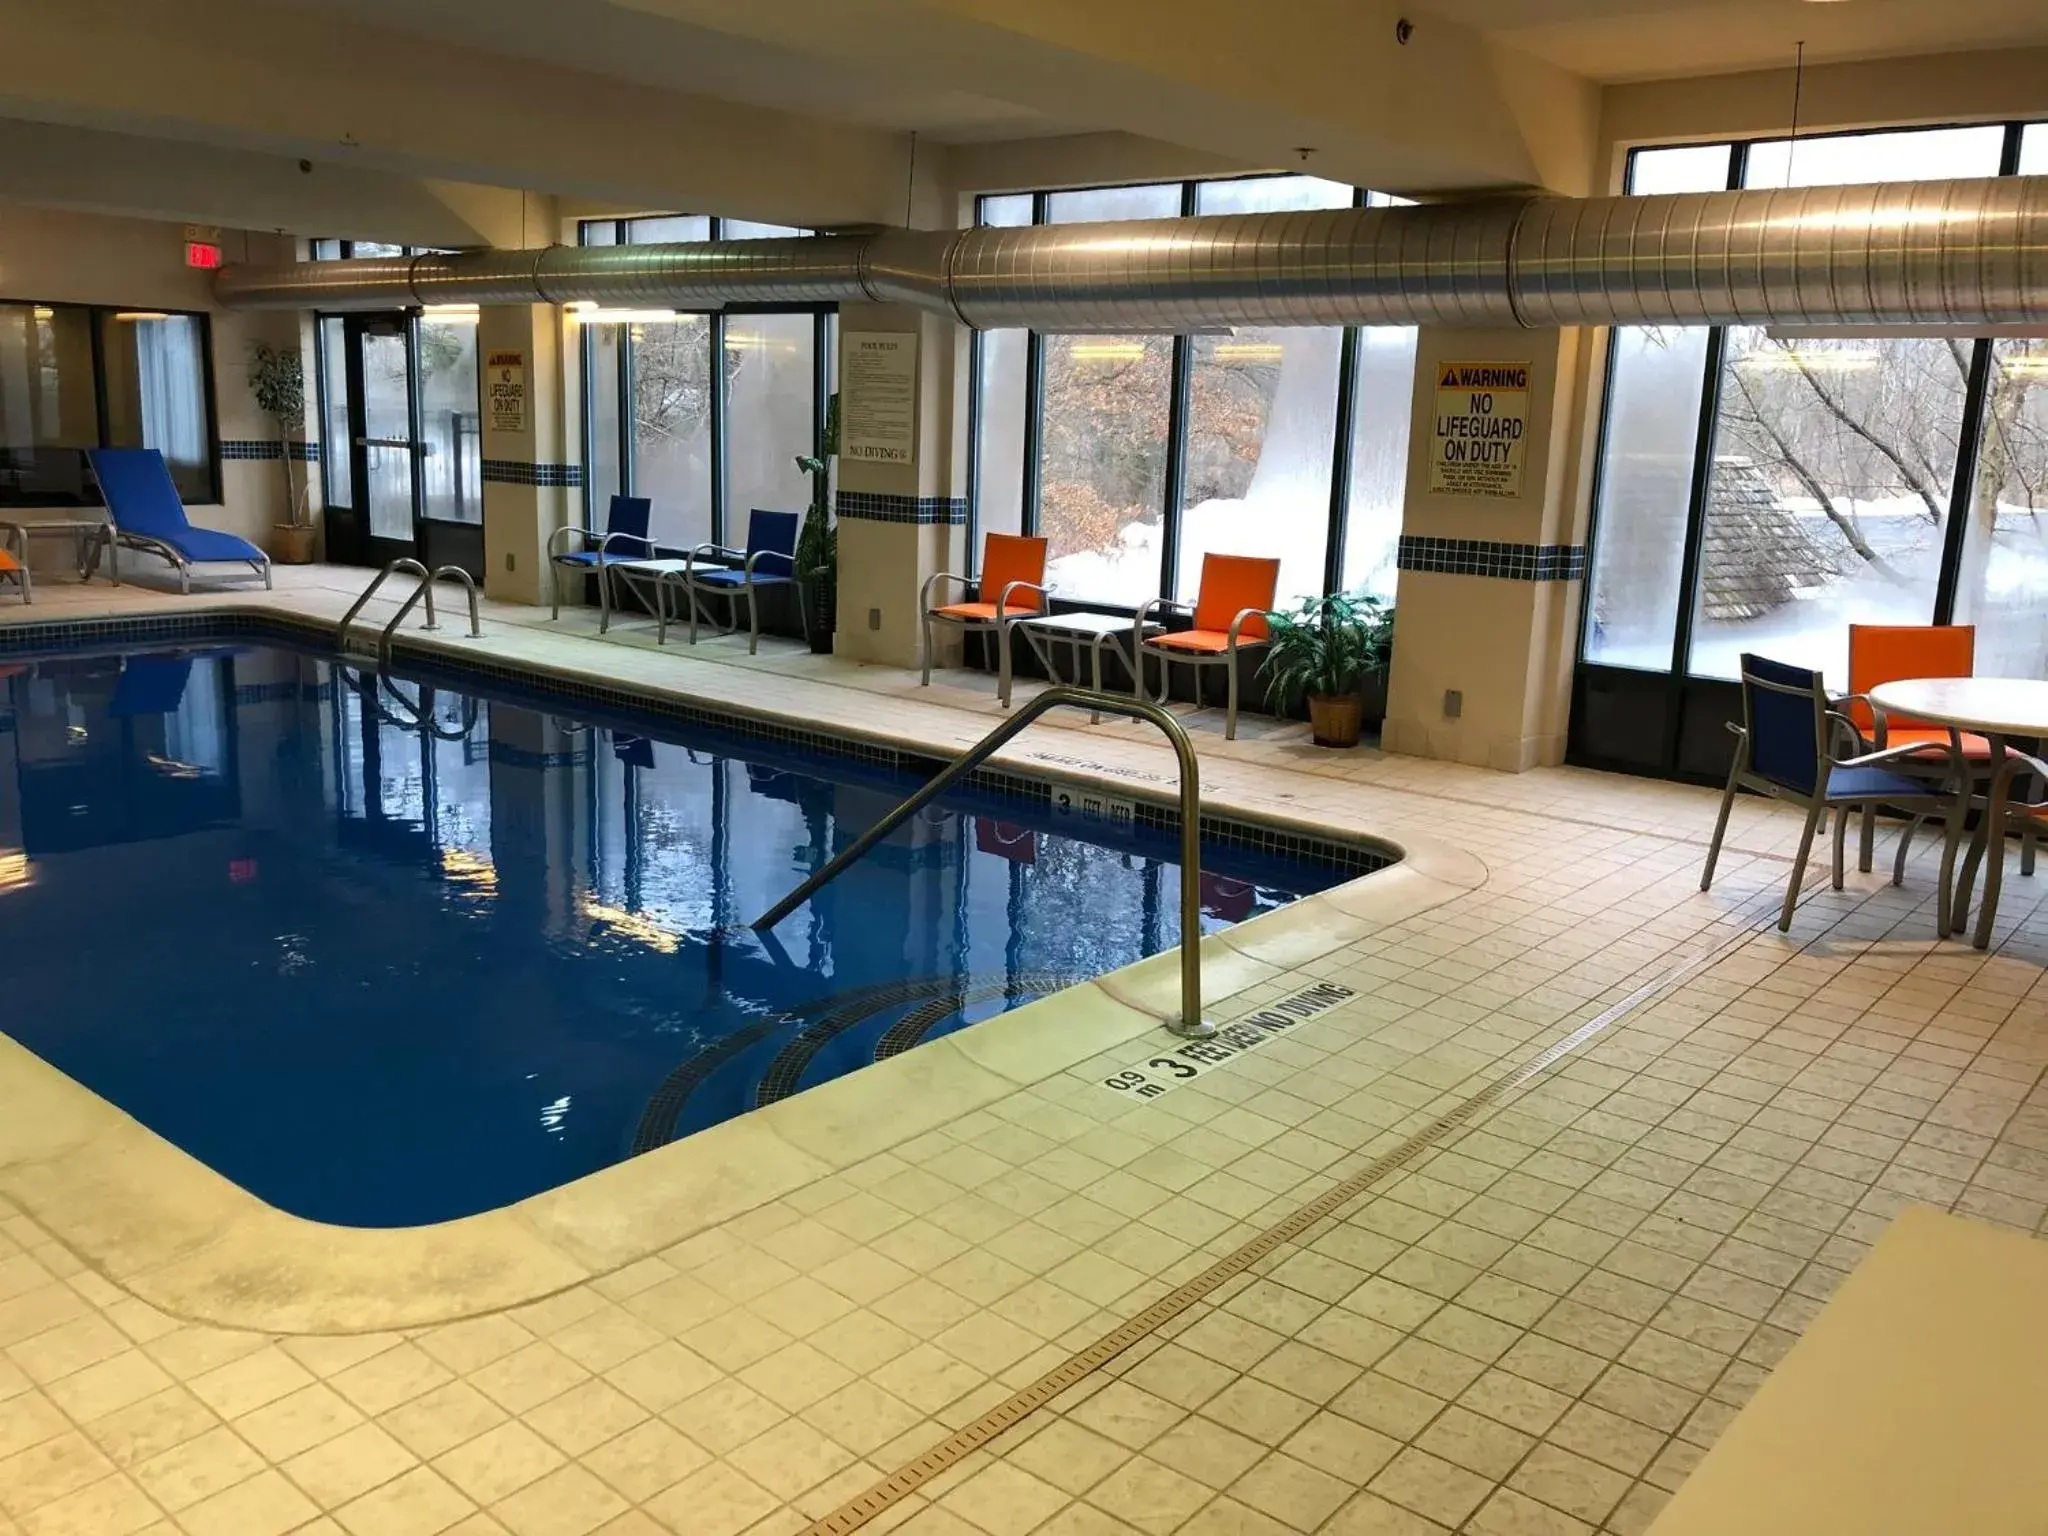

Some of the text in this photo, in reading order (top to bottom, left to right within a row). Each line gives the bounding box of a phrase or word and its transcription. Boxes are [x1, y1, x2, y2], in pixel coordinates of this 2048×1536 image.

[1460, 368, 1527, 387] WARNING
[1470, 393, 1493, 414] NO
[1437, 416, 1523, 439] LIFEGUARD
[849, 445, 898, 459] NO DIVING
[1444, 440, 1512, 462] ON DUTY
[1149, 1058, 1198, 1079] 3
[1176, 1039, 1238, 1066] FEET
[1250, 1011, 1296, 1032] NO
[1277, 982, 1355, 1018] DIVING
[1105, 1071, 1146, 1091] 0.9
[1136, 1083, 1166, 1098] m
